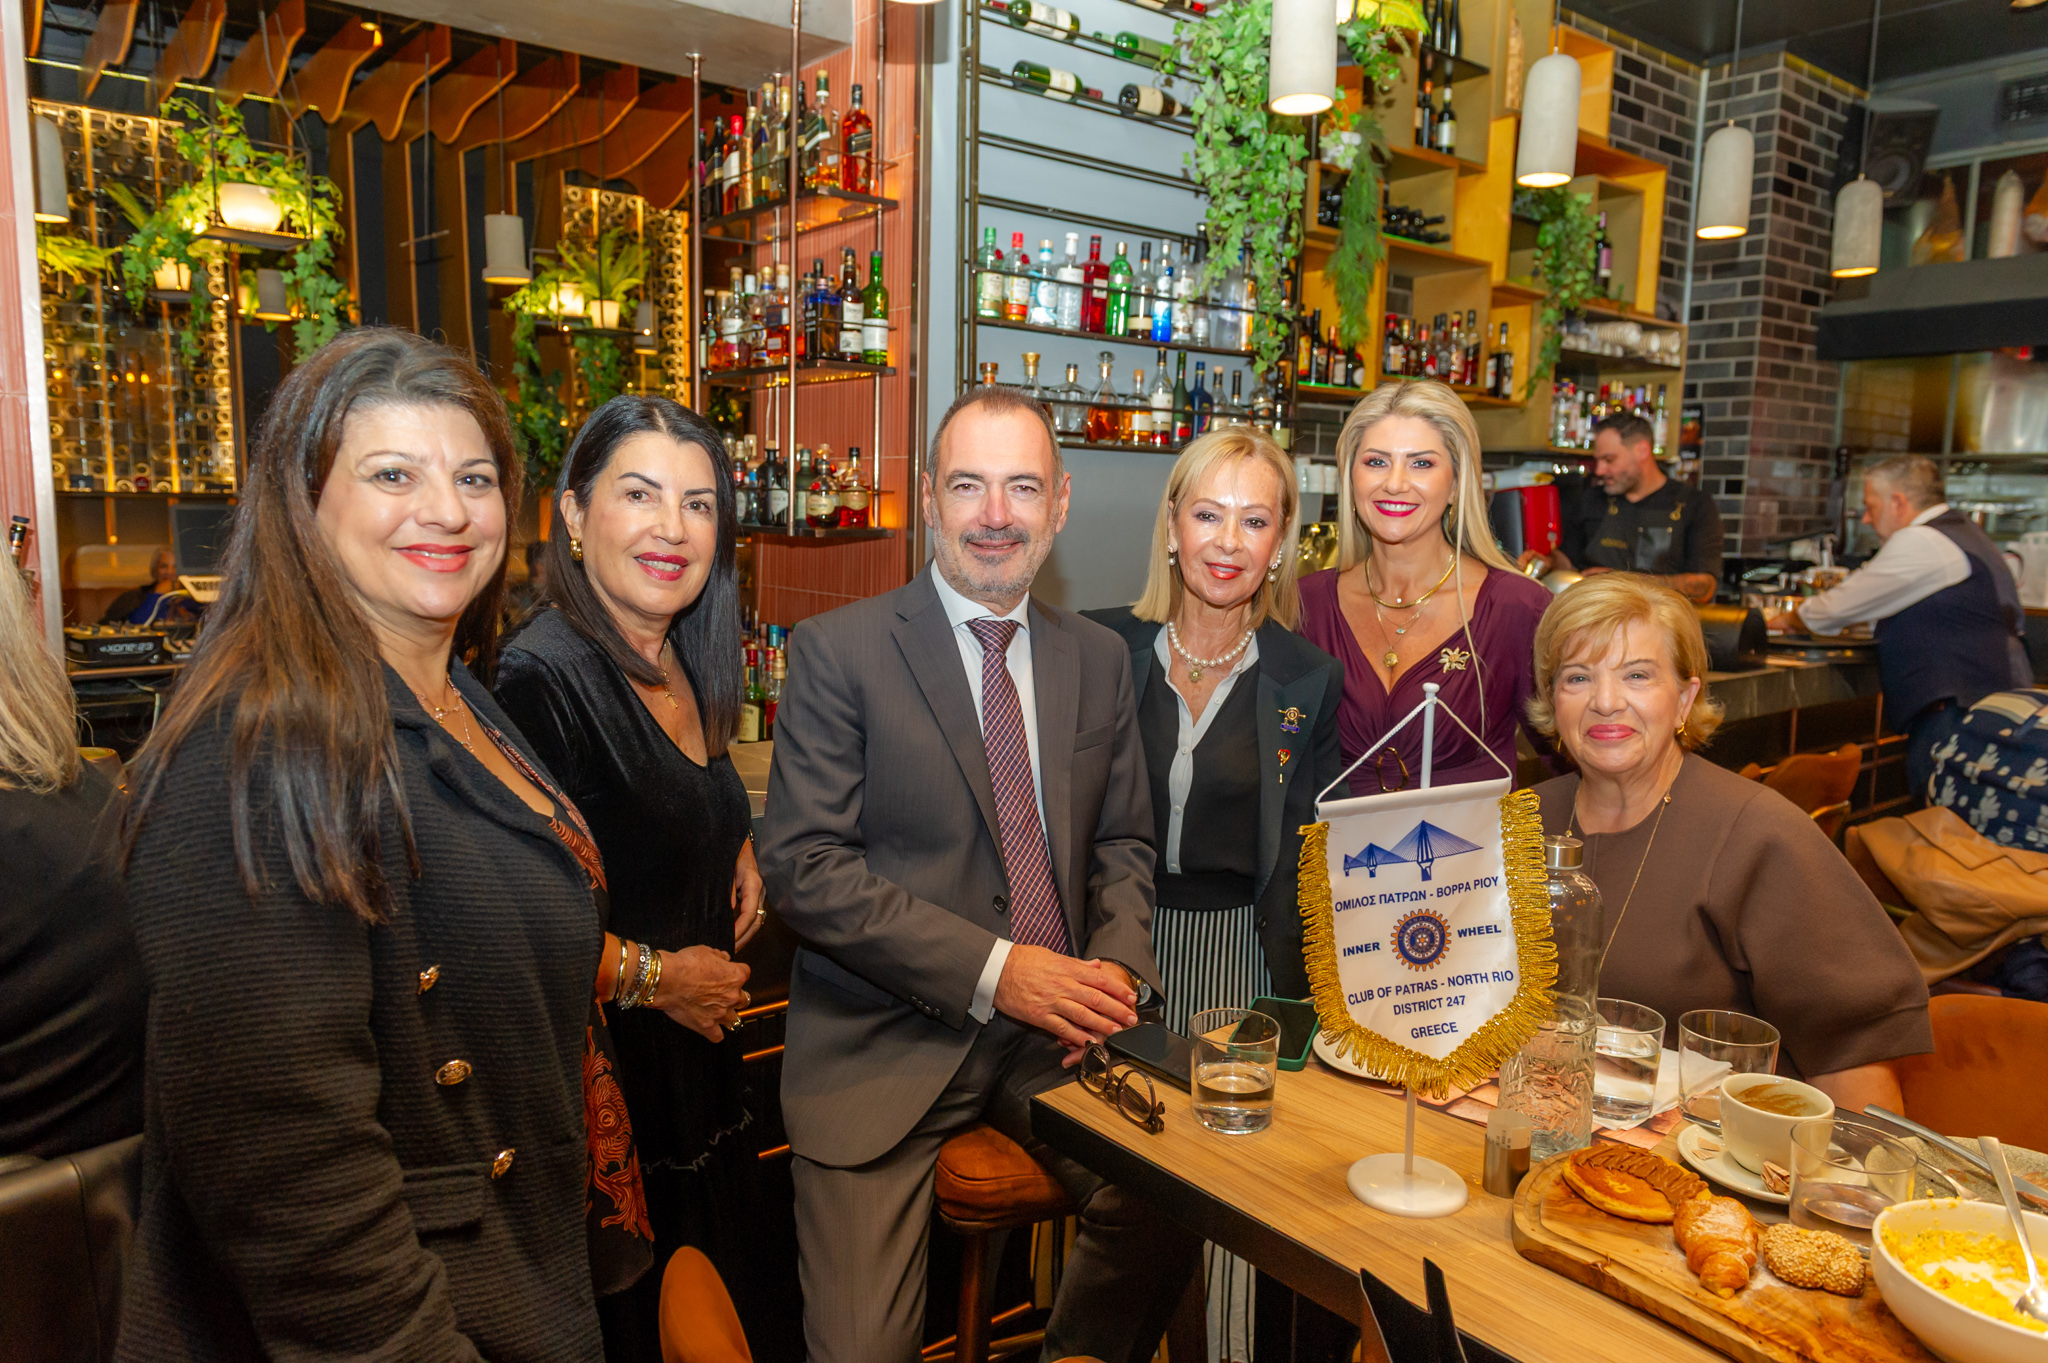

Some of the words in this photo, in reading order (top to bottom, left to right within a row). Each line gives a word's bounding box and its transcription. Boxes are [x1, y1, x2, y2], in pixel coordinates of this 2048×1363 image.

[1335, 894, 1376, 912] ΟΜΙΛΟΣ
[1379, 890, 1427, 904] ΠΑΤΡΩΝ
[1436, 882, 1471, 898] ΒΟΡΡΑ
[1473, 876, 1499, 890] ΡΙΟΥ
[1343, 942, 1381, 957] INNER
[1457, 924, 1502, 938] WHEEL
[1348, 989, 1374, 1005] CLUB
[1377, 986, 1392, 998] OF
[1395, 979, 1438, 996] PATRAS
[1447, 972, 1489, 987] NORTH
[1492, 970, 1514, 982] RIO
[1393, 998, 1443, 1015] DISTRICT
[1446, 995, 1466, 1007] 247
[1411, 1022, 1458, 1039] GREECE
